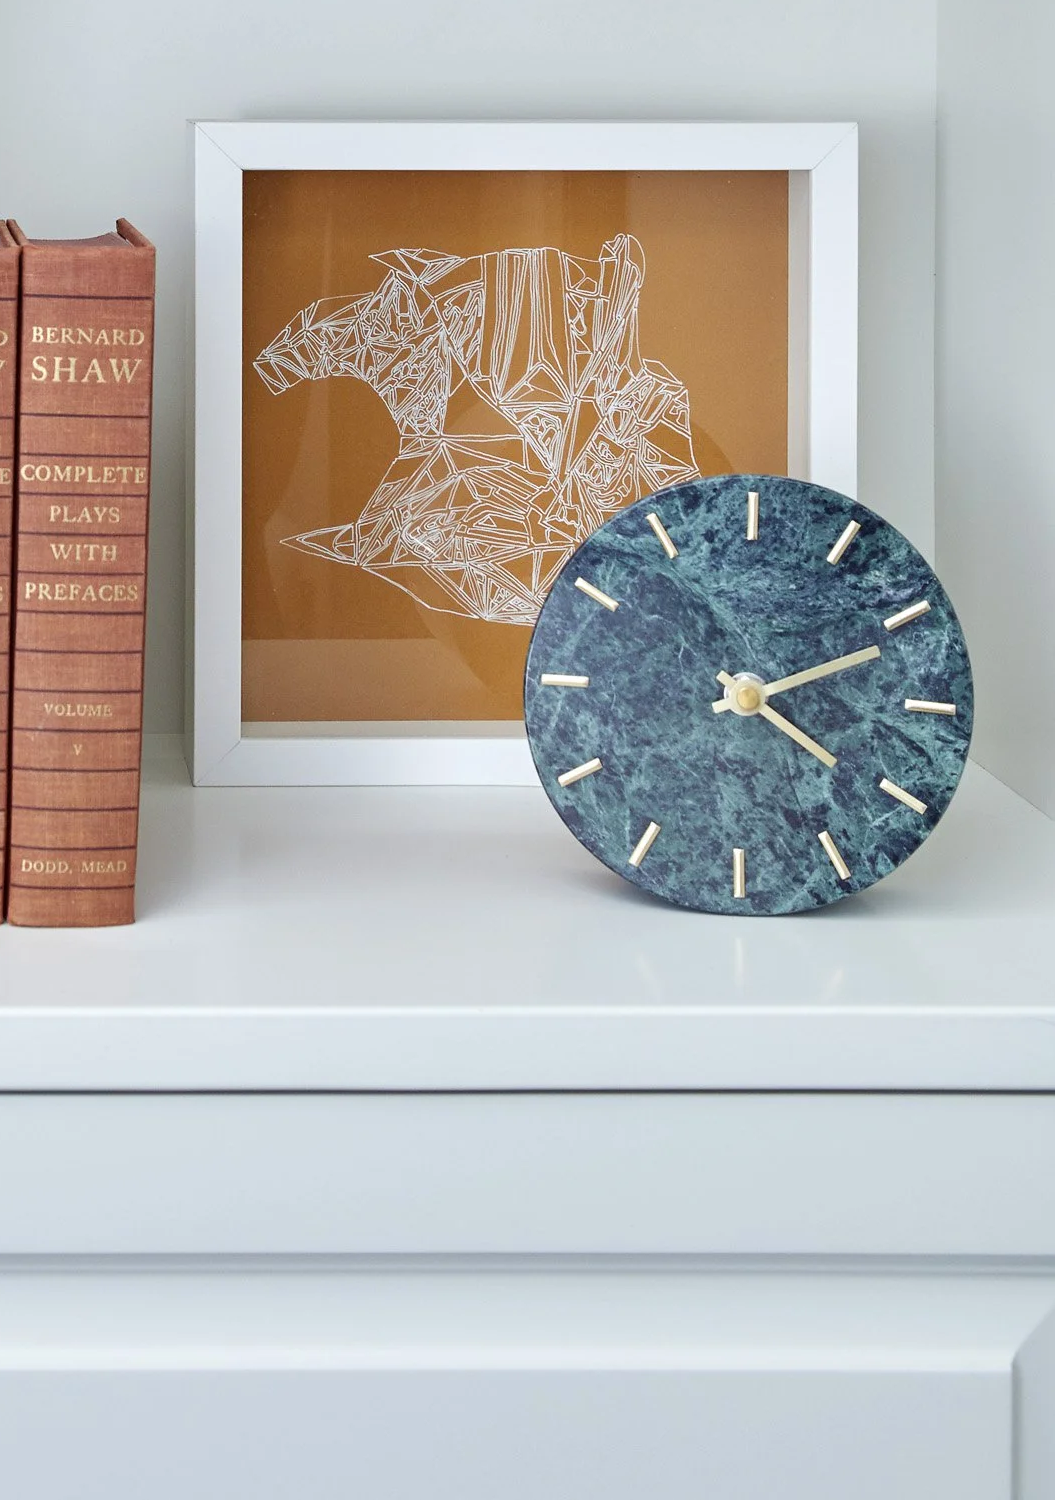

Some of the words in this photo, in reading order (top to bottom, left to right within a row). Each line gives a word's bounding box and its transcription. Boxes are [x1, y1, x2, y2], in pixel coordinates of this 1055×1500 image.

[32, 326, 145, 345] BERNARD
[31, 356, 142, 384] SHAW
[20, 465, 146, 484] COMPLETE
[49, 505, 120, 524] PLAYS
[50, 543, 117, 561] WITH
[25, 582, 138, 601] PREFACES
[44, 703, 113, 717] VOLUME
[21, 859, 73, 875] DODD,
[81, 860, 127, 873] MEAD
